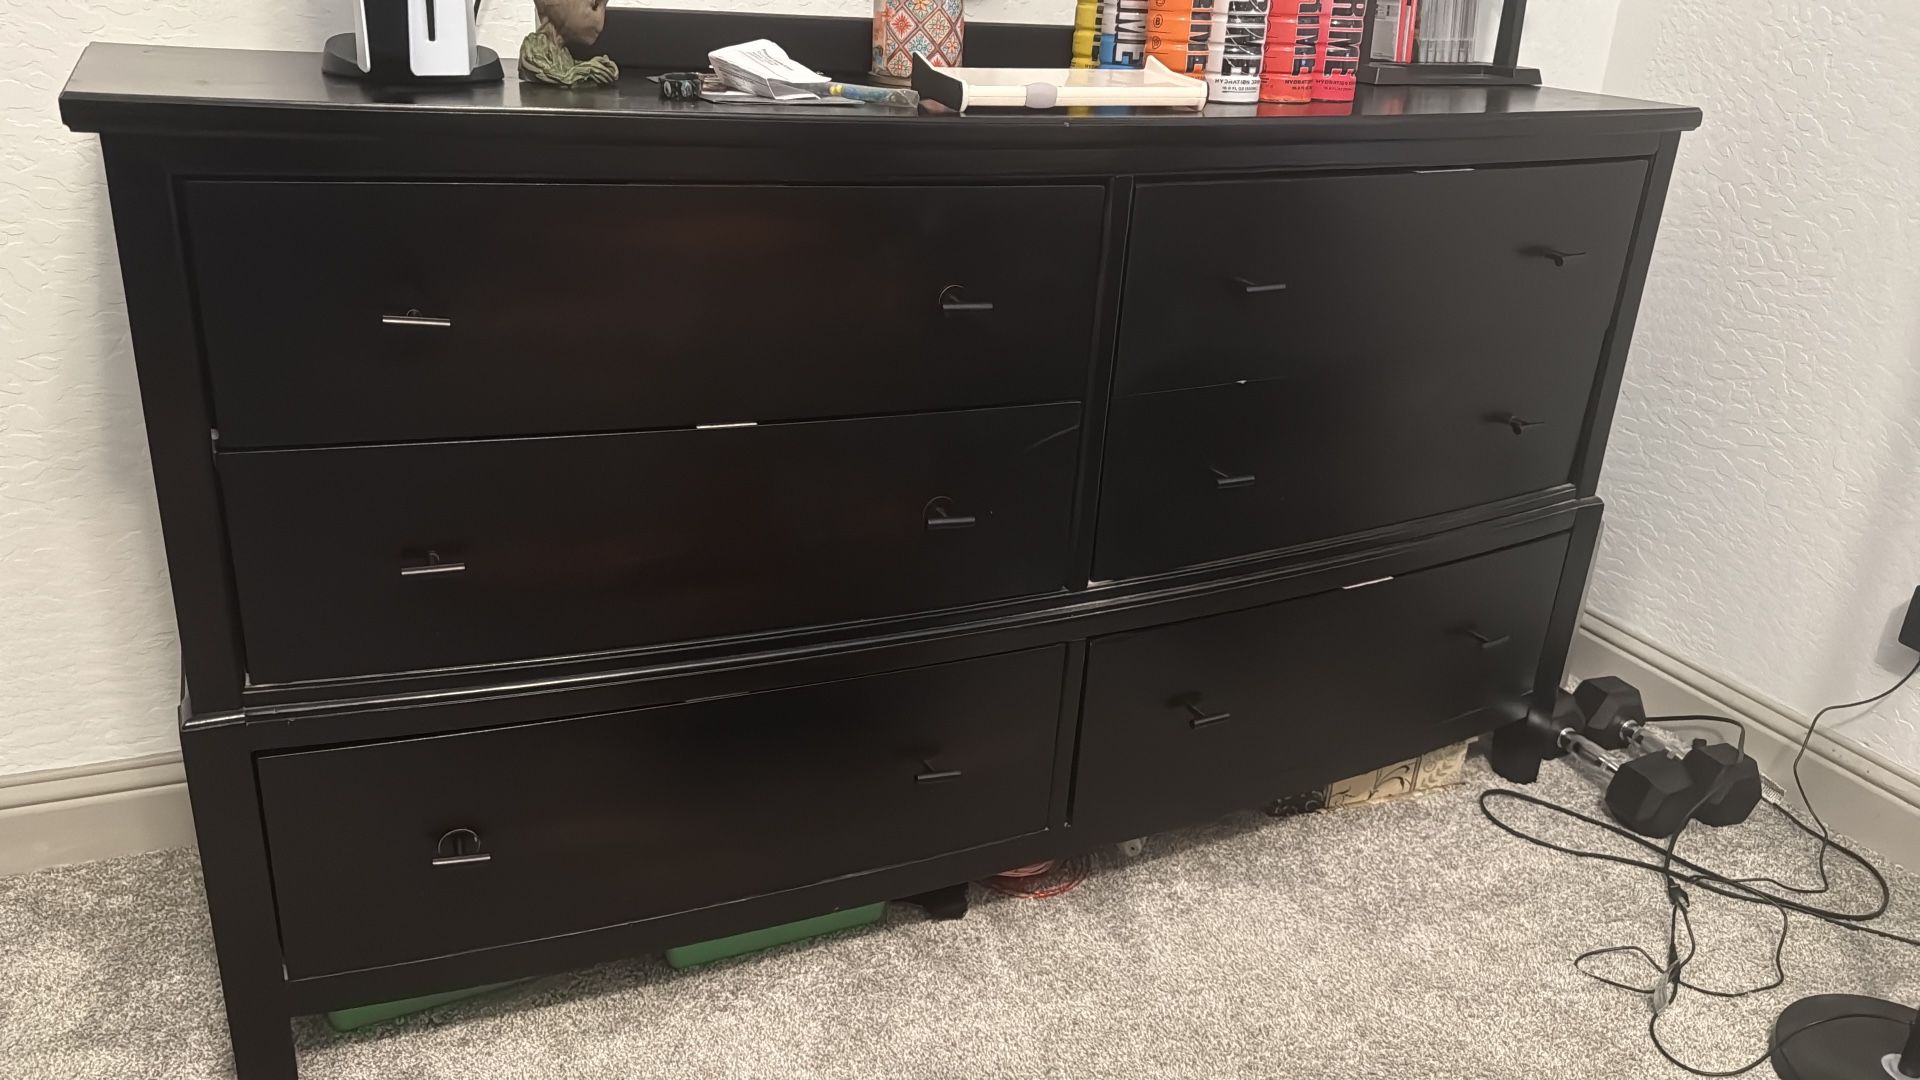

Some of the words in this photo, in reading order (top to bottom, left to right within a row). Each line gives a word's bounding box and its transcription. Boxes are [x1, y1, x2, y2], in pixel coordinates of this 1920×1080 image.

[1113, 0, 1147, 64] IME
[1186, 0, 1213, 73] IME
[1221, 0, 1268, 76] RIME
[1324, 0, 1367, 78] RIME
